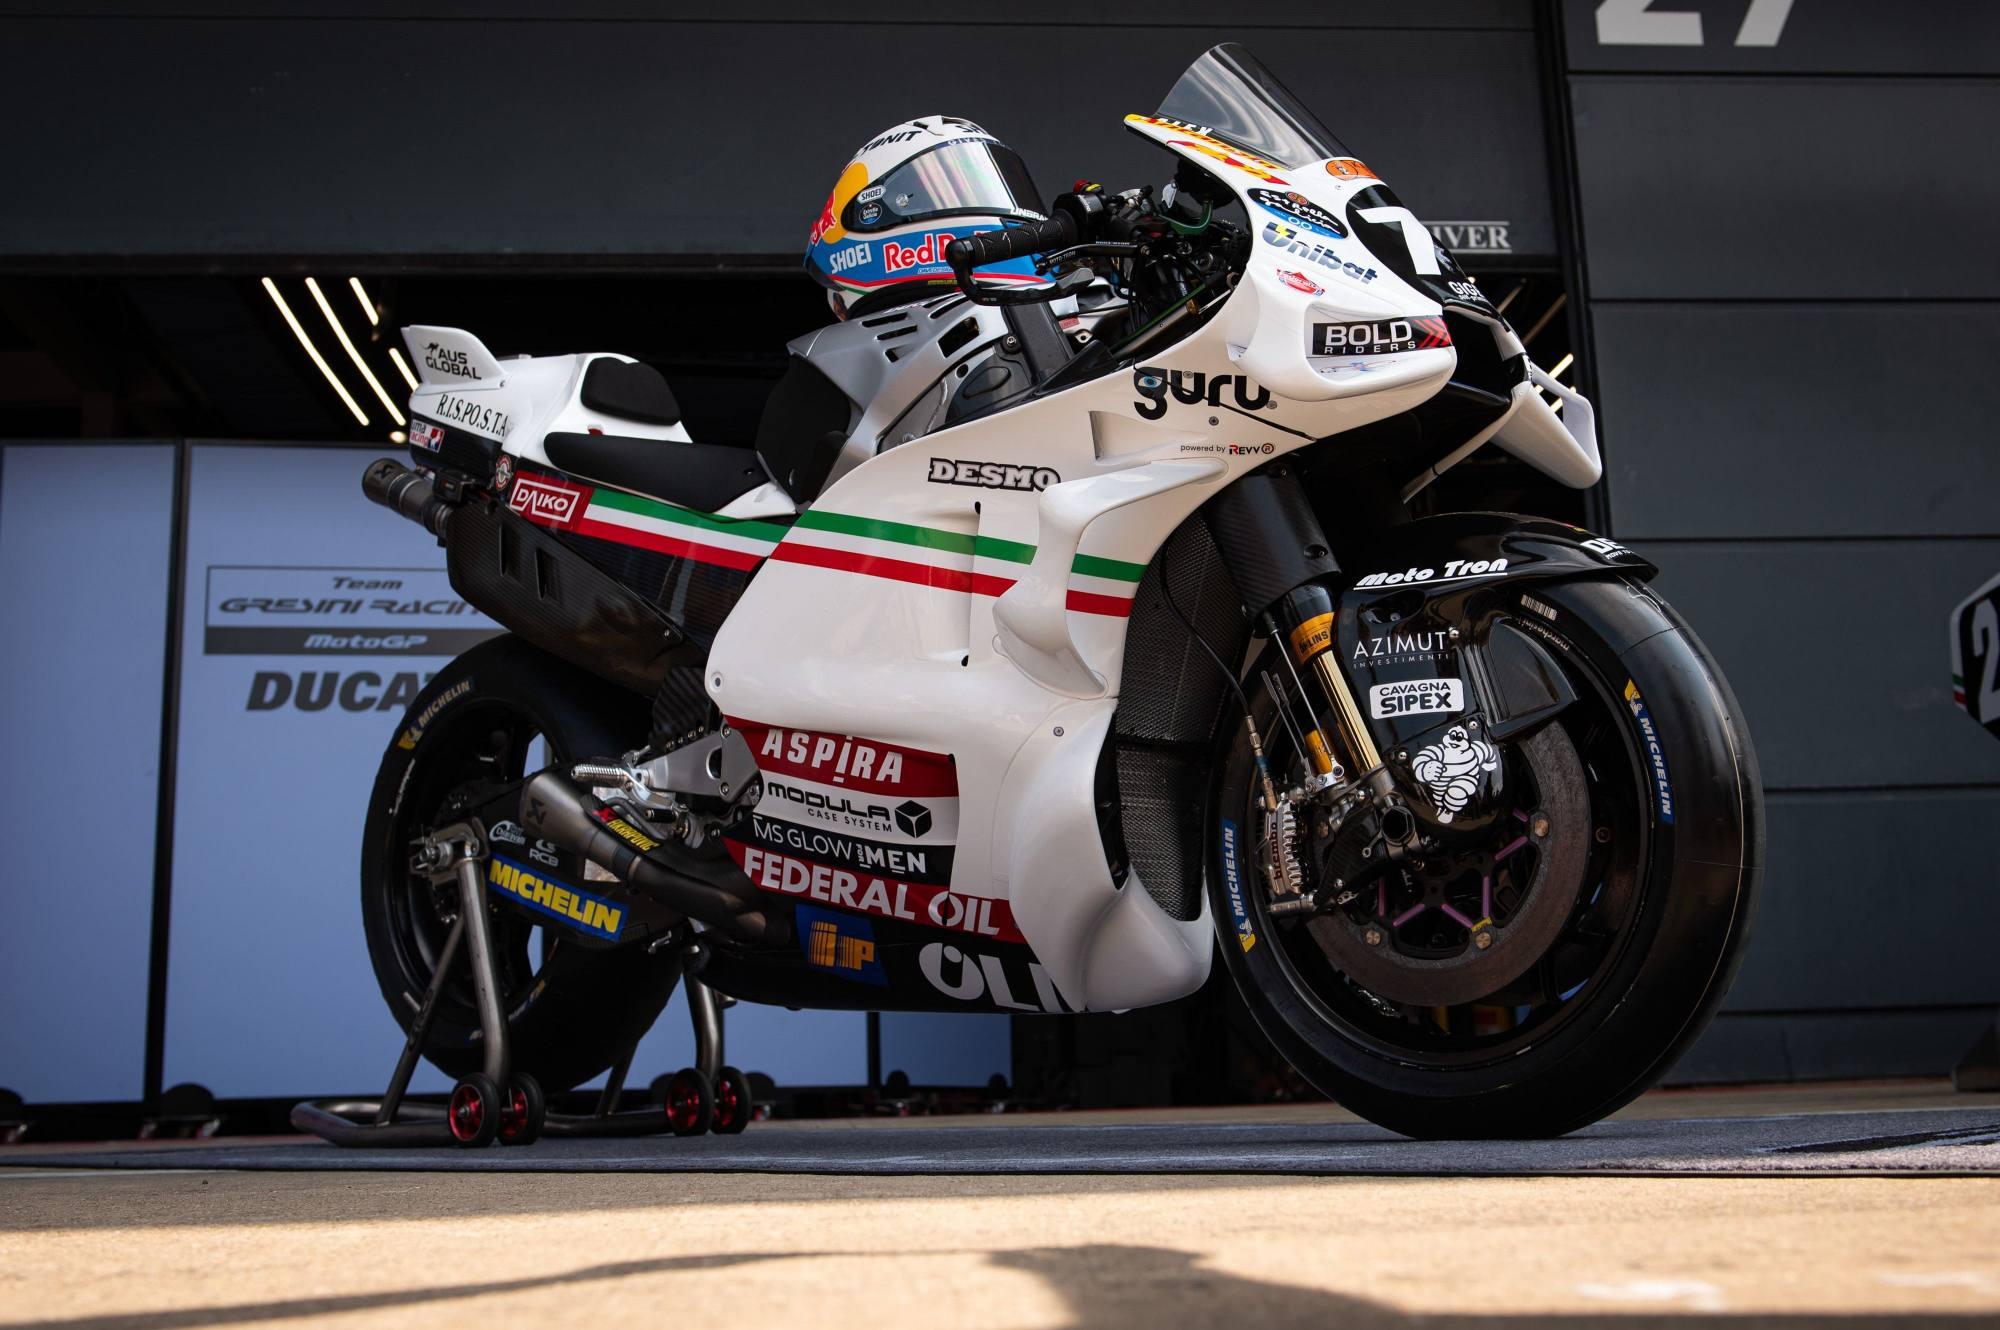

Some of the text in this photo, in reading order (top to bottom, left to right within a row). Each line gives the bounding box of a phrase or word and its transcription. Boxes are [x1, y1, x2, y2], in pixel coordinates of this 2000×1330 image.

[861, 188, 882, 201] SHOEI
[1432, 225, 1511, 249] IVER
[829, 242, 872, 275] SHOEI
[883, 234, 935, 273] Red
[1262, 221, 1378, 285] Unibat
[1325, 321, 1412, 346] BOLD
[437, 347, 468, 364] AUS
[1324, 340, 1416, 354] RIDERS
[425, 356, 482, 380] GLOBAL
[1134, 366, 1271, 420] guru
[410, 431, 430, 447] acing
[1180, 445, 1214, 453] powered
[1216, 444, 1226, 453] by
[928, 457, 1061, 492] DESMO
[333, 576, 403, 591] Team
[1354, 558, 1508, 590] Moto Tron
[218, 598, 482, 615] GRESINI RACIN
[304, 634, 429, 649] MotoGP
[1353, 631, 1447, 660] AZIMUT
[1353, 653, 1450, 670] INVESTIMENTI
[246, 671, 441, 713] DUCA
[1379, 682, 1451, 697] CAVAGNA
[417, 681, 470, 728] MICHELIN
[1381, 692, 1452, 715] SIPEX
[1640, 716, 1672, 816] MICHELIN
[807, 808, 893, 832] CASE SYSTEM
[753, 813, 784, 844] MS
[787, 827, 852, 860] GLOW
[867, 845, 927, 874] MEN
[1269, 822, 1284, 881] brembo
[529, 847, 559, 868] RCB
[1222, 827, 1246, 918] MICHELIN
[489, 858, 622, 933] MICHELIN
[744, 847, 1000, 936] FEDERAL OIL
